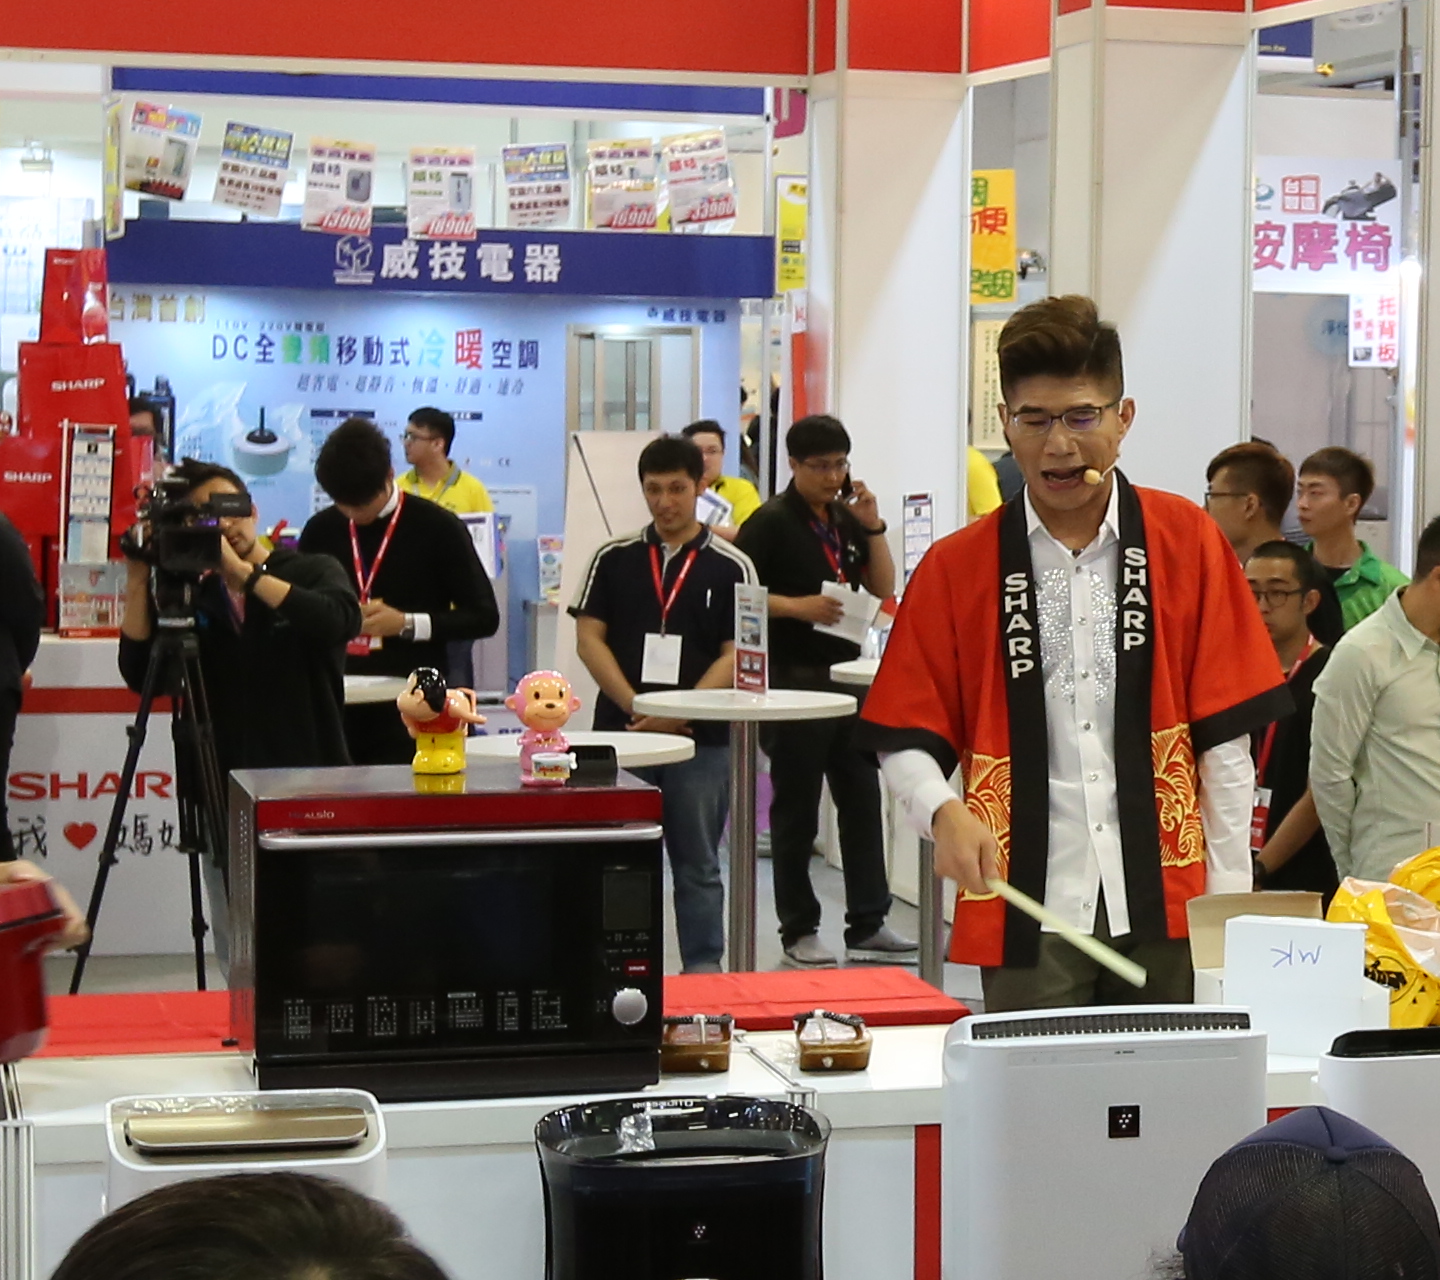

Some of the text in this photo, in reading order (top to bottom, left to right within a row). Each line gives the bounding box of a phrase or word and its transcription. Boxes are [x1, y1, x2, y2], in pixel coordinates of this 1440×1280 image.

[380, 240, 562, 283] 威技電器
[51, 378, 105, 393] SHARP
[3, 471, 53, 484] SHARP
[1122, 546, 1148, 651] SHARP
[1004, 572, 1036, 680] SHARP
[7, 771, 174, 801] SHAR
[12, 815, 49, 858] 我
